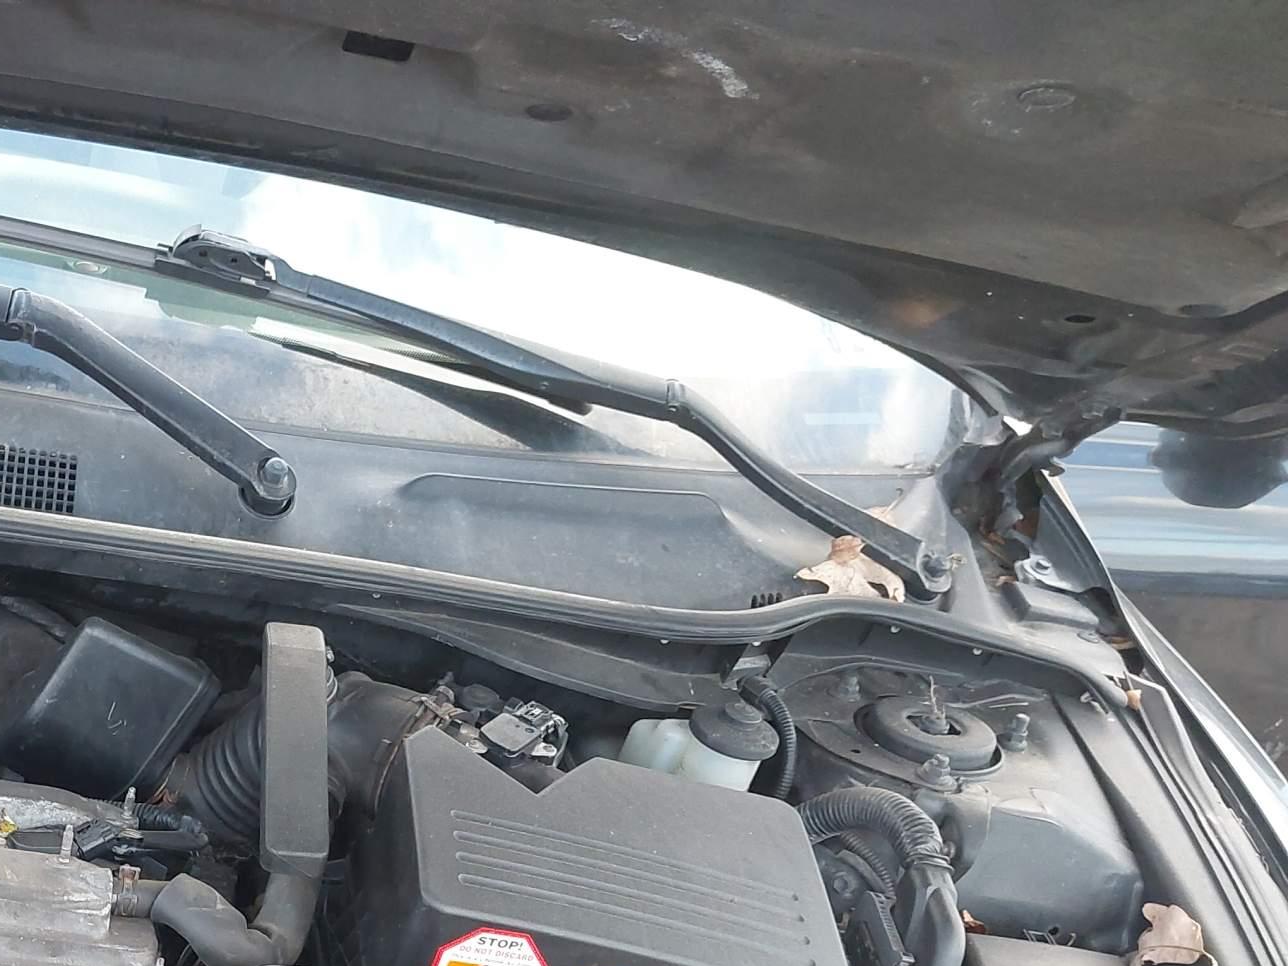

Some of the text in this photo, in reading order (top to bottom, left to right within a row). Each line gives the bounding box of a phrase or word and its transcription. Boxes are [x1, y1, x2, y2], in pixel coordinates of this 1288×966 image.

[478, 936, 524, 951] STOP!
[459, 945, 472, 953] DO
[474, 947, 493, 956] NOT
[495, 949, 535, 962] DISCARD
